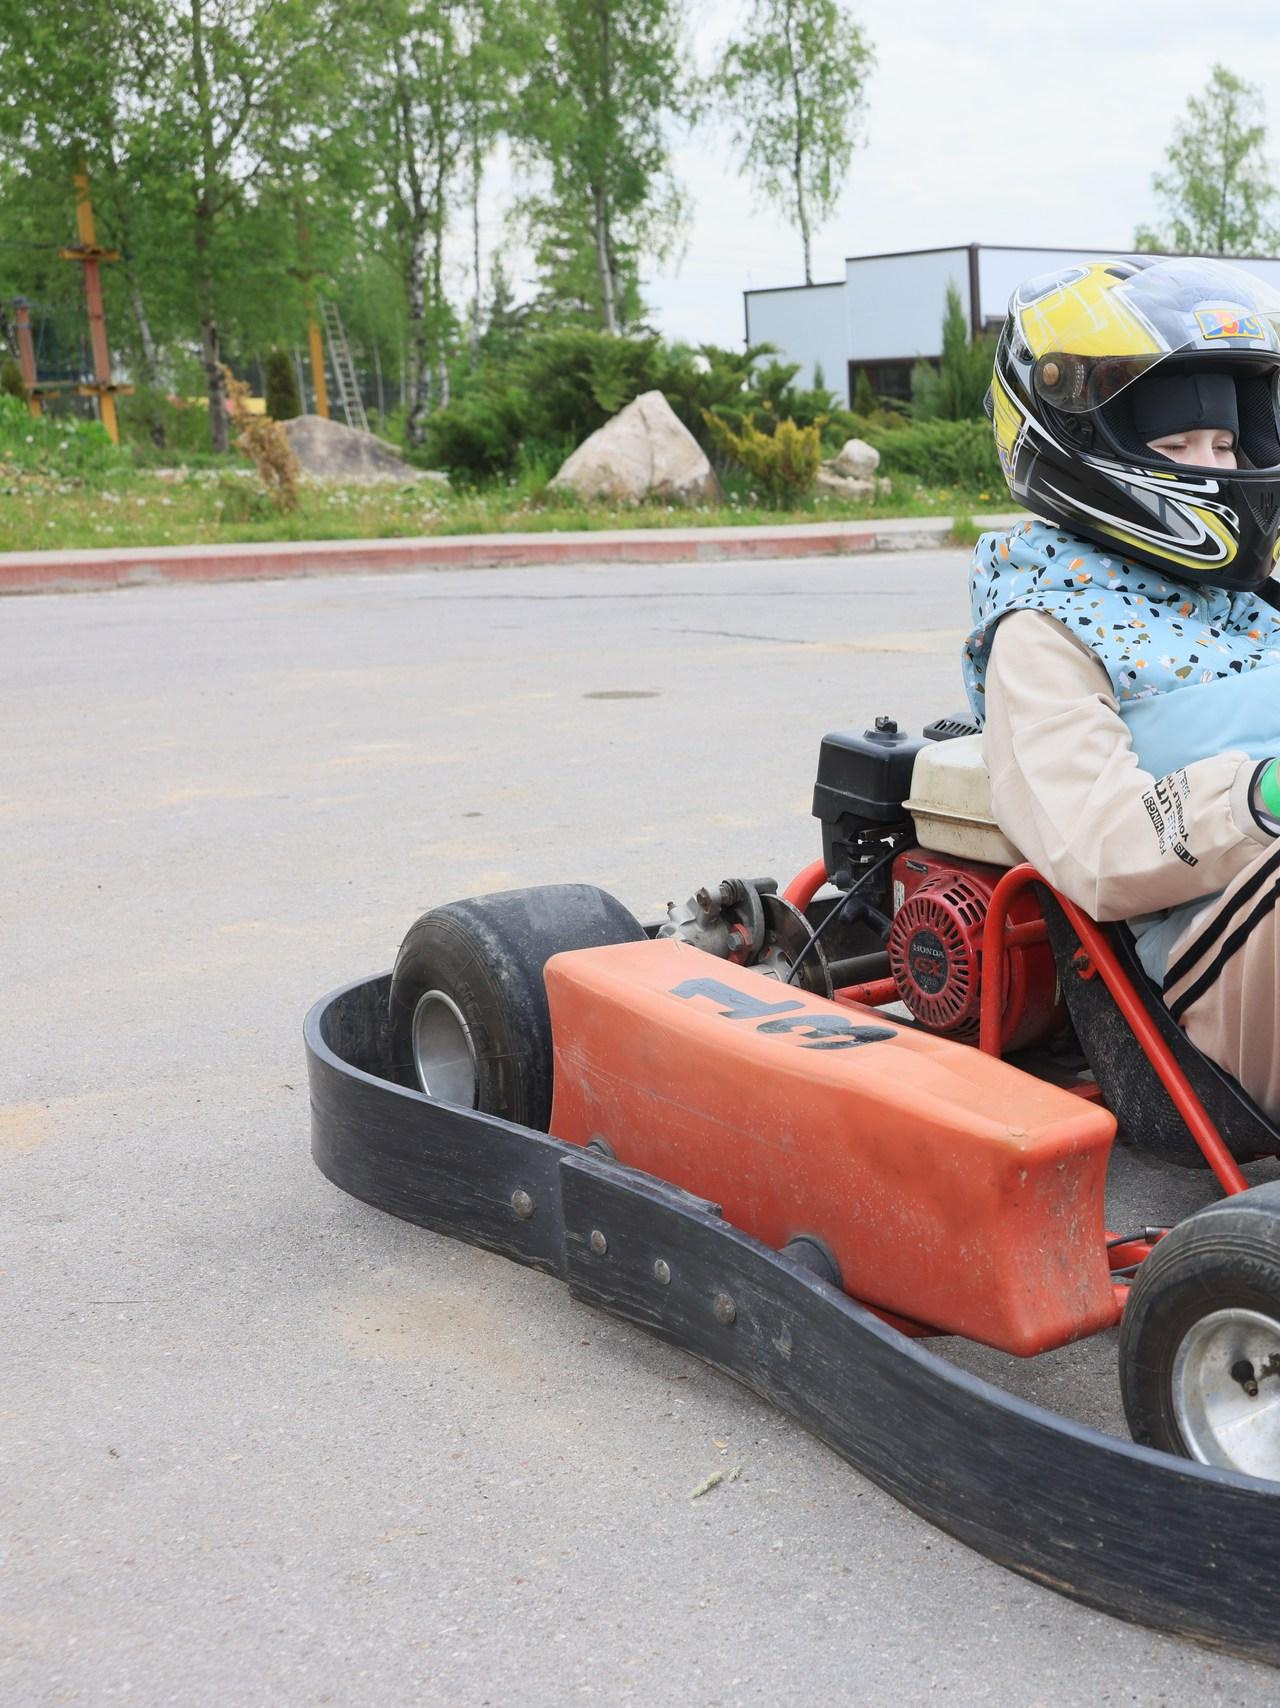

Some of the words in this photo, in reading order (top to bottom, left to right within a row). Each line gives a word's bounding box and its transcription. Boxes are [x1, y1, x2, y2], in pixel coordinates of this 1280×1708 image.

[1143, 796, 1165, 837] THINGS
[1172, 791, 1189, 842] YOURSELF
[912, 943, 945, 958] HONDA
[669, 977, 898, 1050] 13
